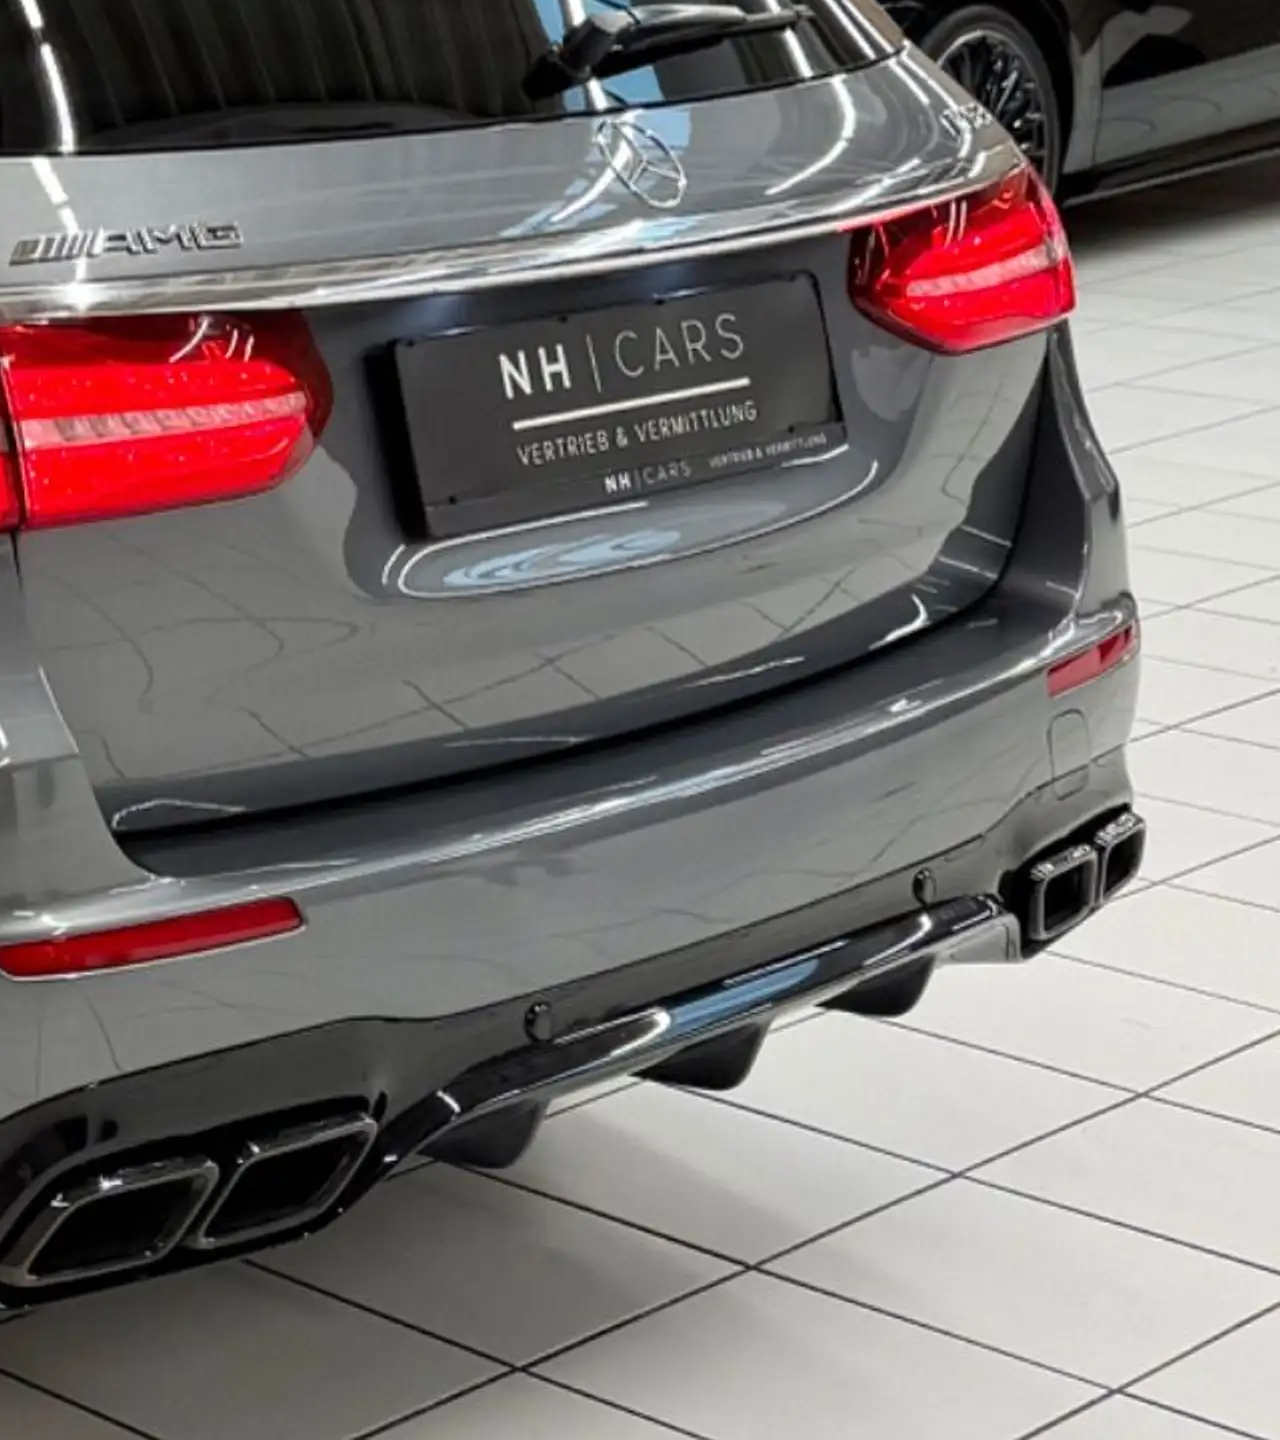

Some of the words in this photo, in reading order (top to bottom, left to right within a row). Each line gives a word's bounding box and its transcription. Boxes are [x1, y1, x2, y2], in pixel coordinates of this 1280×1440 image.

[498, 343, 572, 400] NH
[614, 313, 744, 379] CARS
[516, 429, 610, 466] VERTRIEB
[615, 425, 629, 449] &
[633, 399, 758, 444] VERMITTLUNG
[604, 470, 632, 495] NH
[643, 460, 692, 485] CARS
